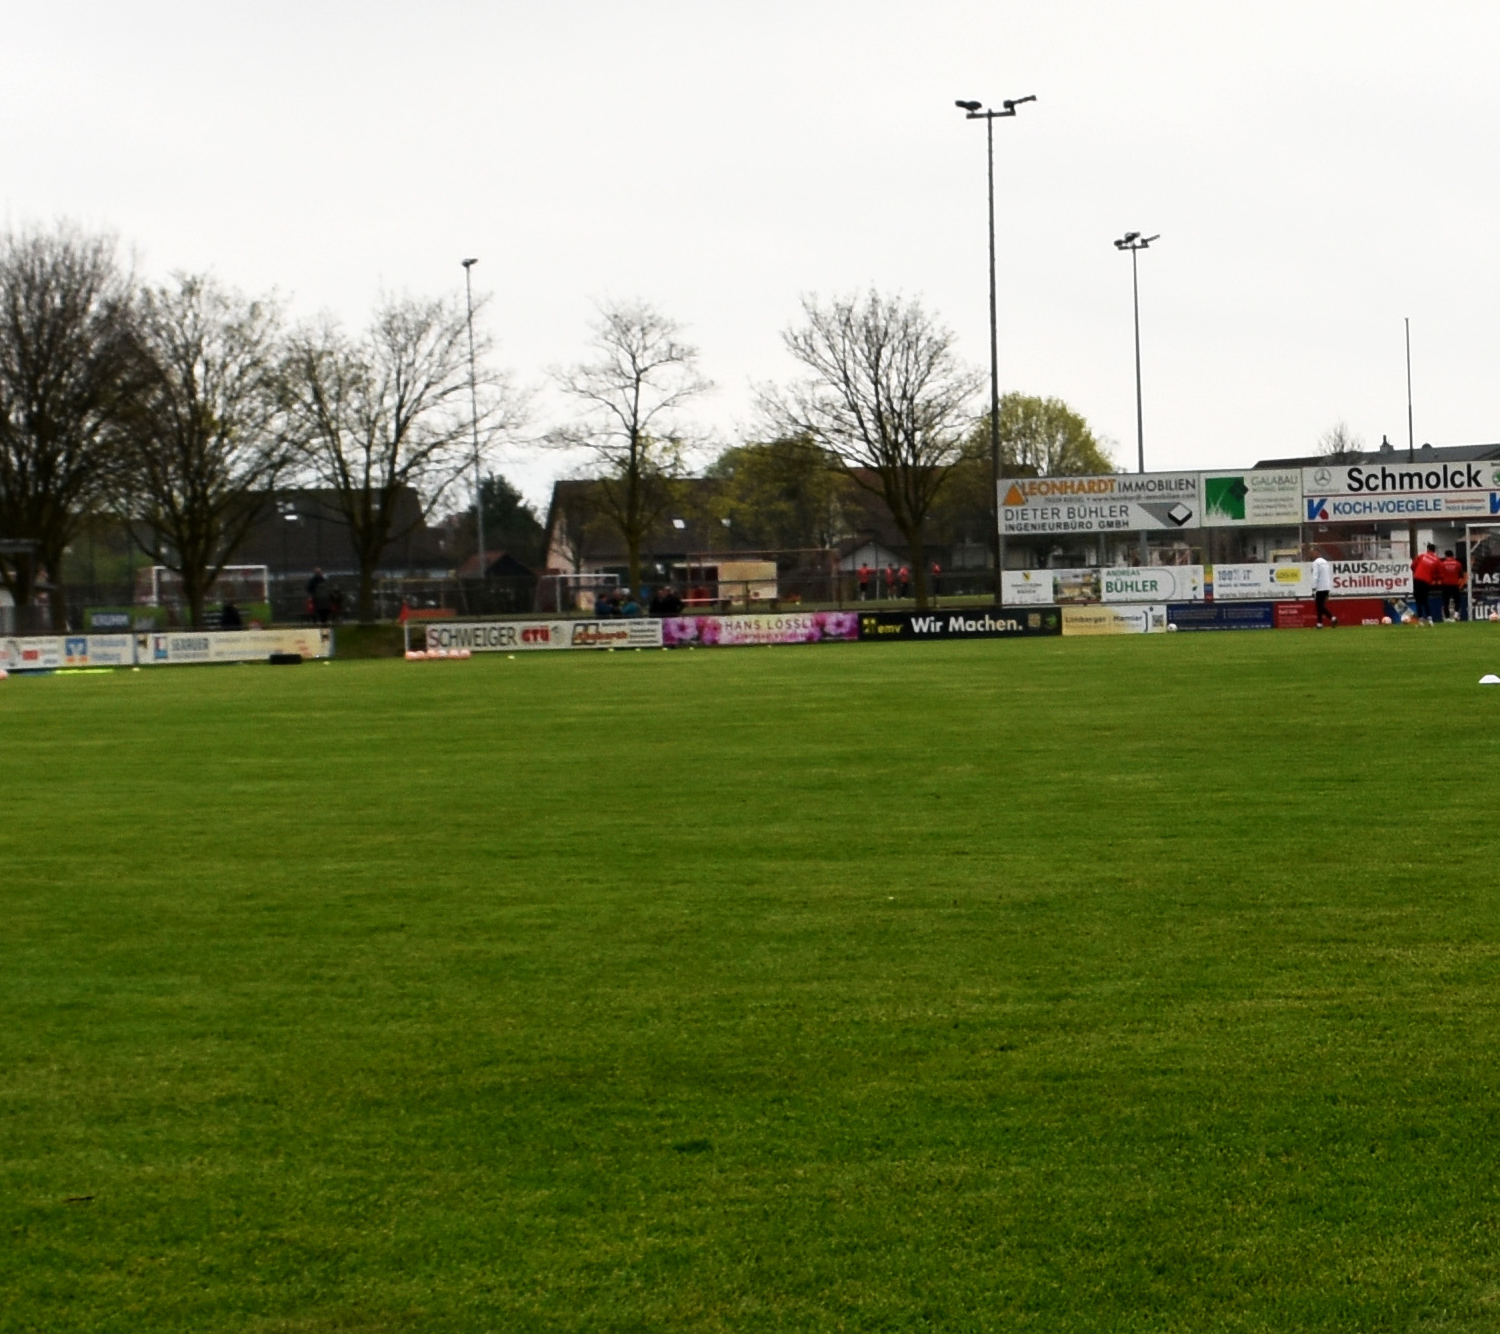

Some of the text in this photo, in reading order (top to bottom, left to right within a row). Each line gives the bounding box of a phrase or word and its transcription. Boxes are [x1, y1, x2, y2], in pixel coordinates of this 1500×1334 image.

[1346, 463, 1484, 492] Schmolck
[1022, 478, 1196, 496] LEONHARDT IMMOBILIEN
[1004, 504, 1129, 522] DIETER BÜHLER
[1332, 498, 1442, 515] KOCH-VOEGELE
[1004, 520, 1130, 533] INGENIEURBÜRO GMBH
[1105, 578, 1158, 594] BÜHLER
[1332, 575, 1410, 590] Schillinger
[725, 619, 762, 631] HANS
[911, 615, 1024, 634] Wir Machen.
[427, 626, 518, 648] SCHWEIGER
